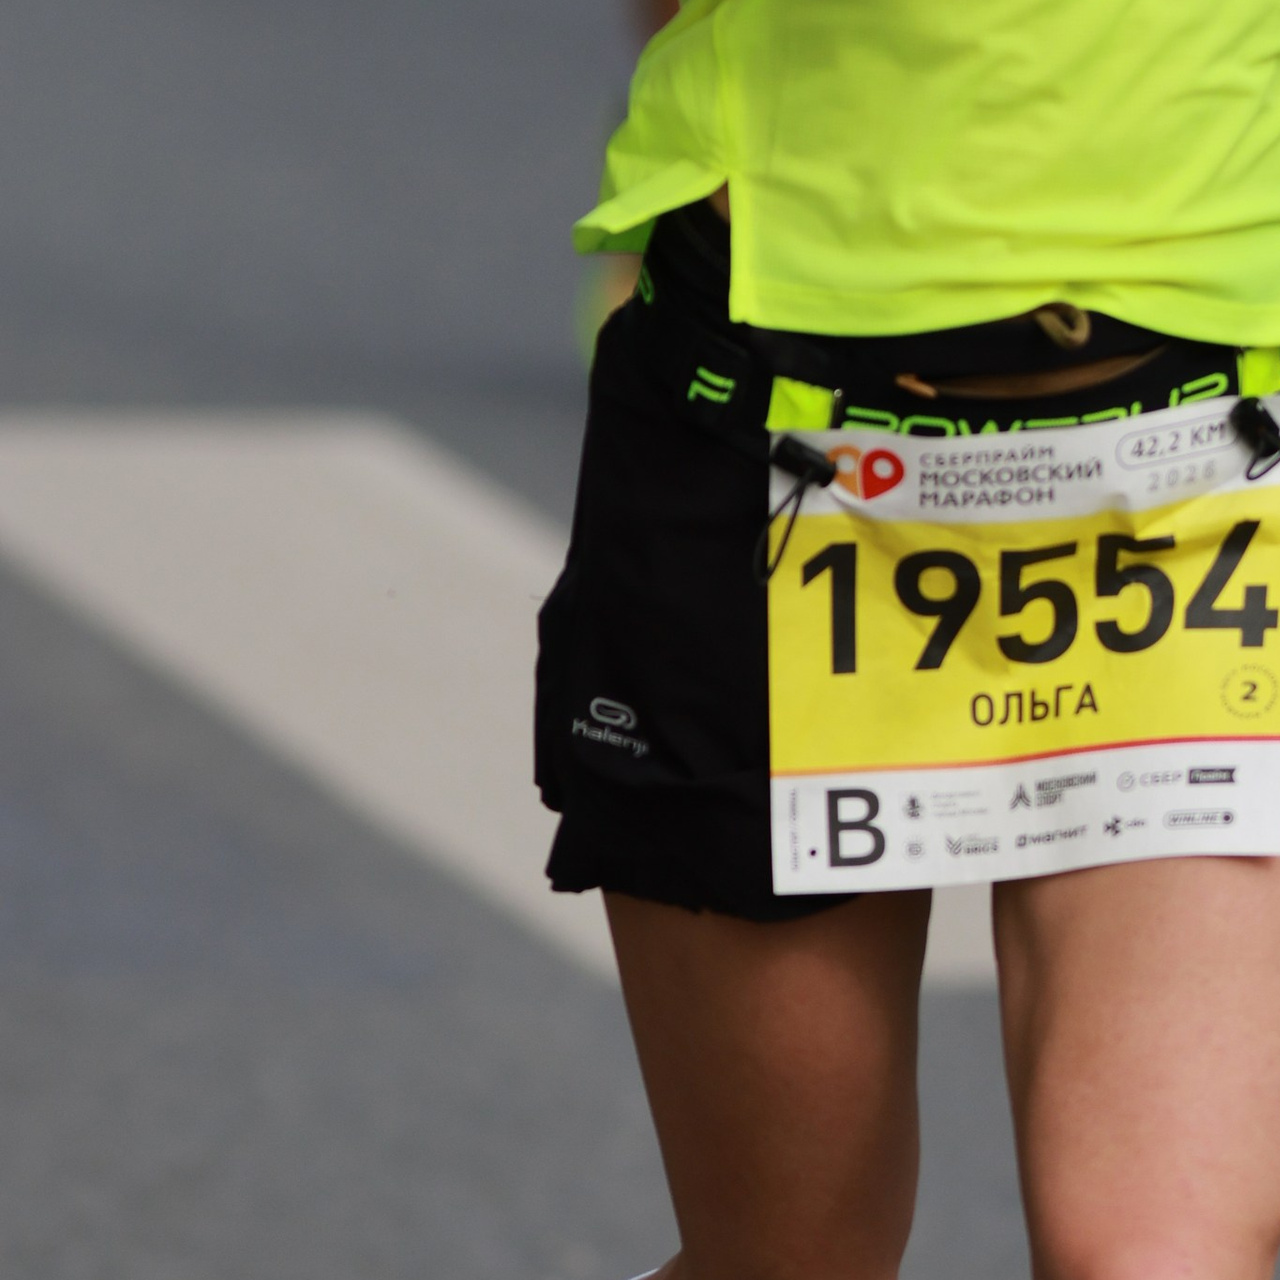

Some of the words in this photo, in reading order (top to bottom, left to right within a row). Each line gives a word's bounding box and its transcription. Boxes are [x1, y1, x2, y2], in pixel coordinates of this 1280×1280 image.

[919, 445, 1054, 467] СБЕРПРАЙМ
[919, 458, 1103, 487] МОСКОВСКИЙ
[919, 487, 1054, 508] МАРАФОН
[802, 519, 1279, 674] 19554
[971, 683, 1099, 727] ОЛЬГА
[1241, 680, 1258, 701] 2
[827, 788, 886, 868] B
